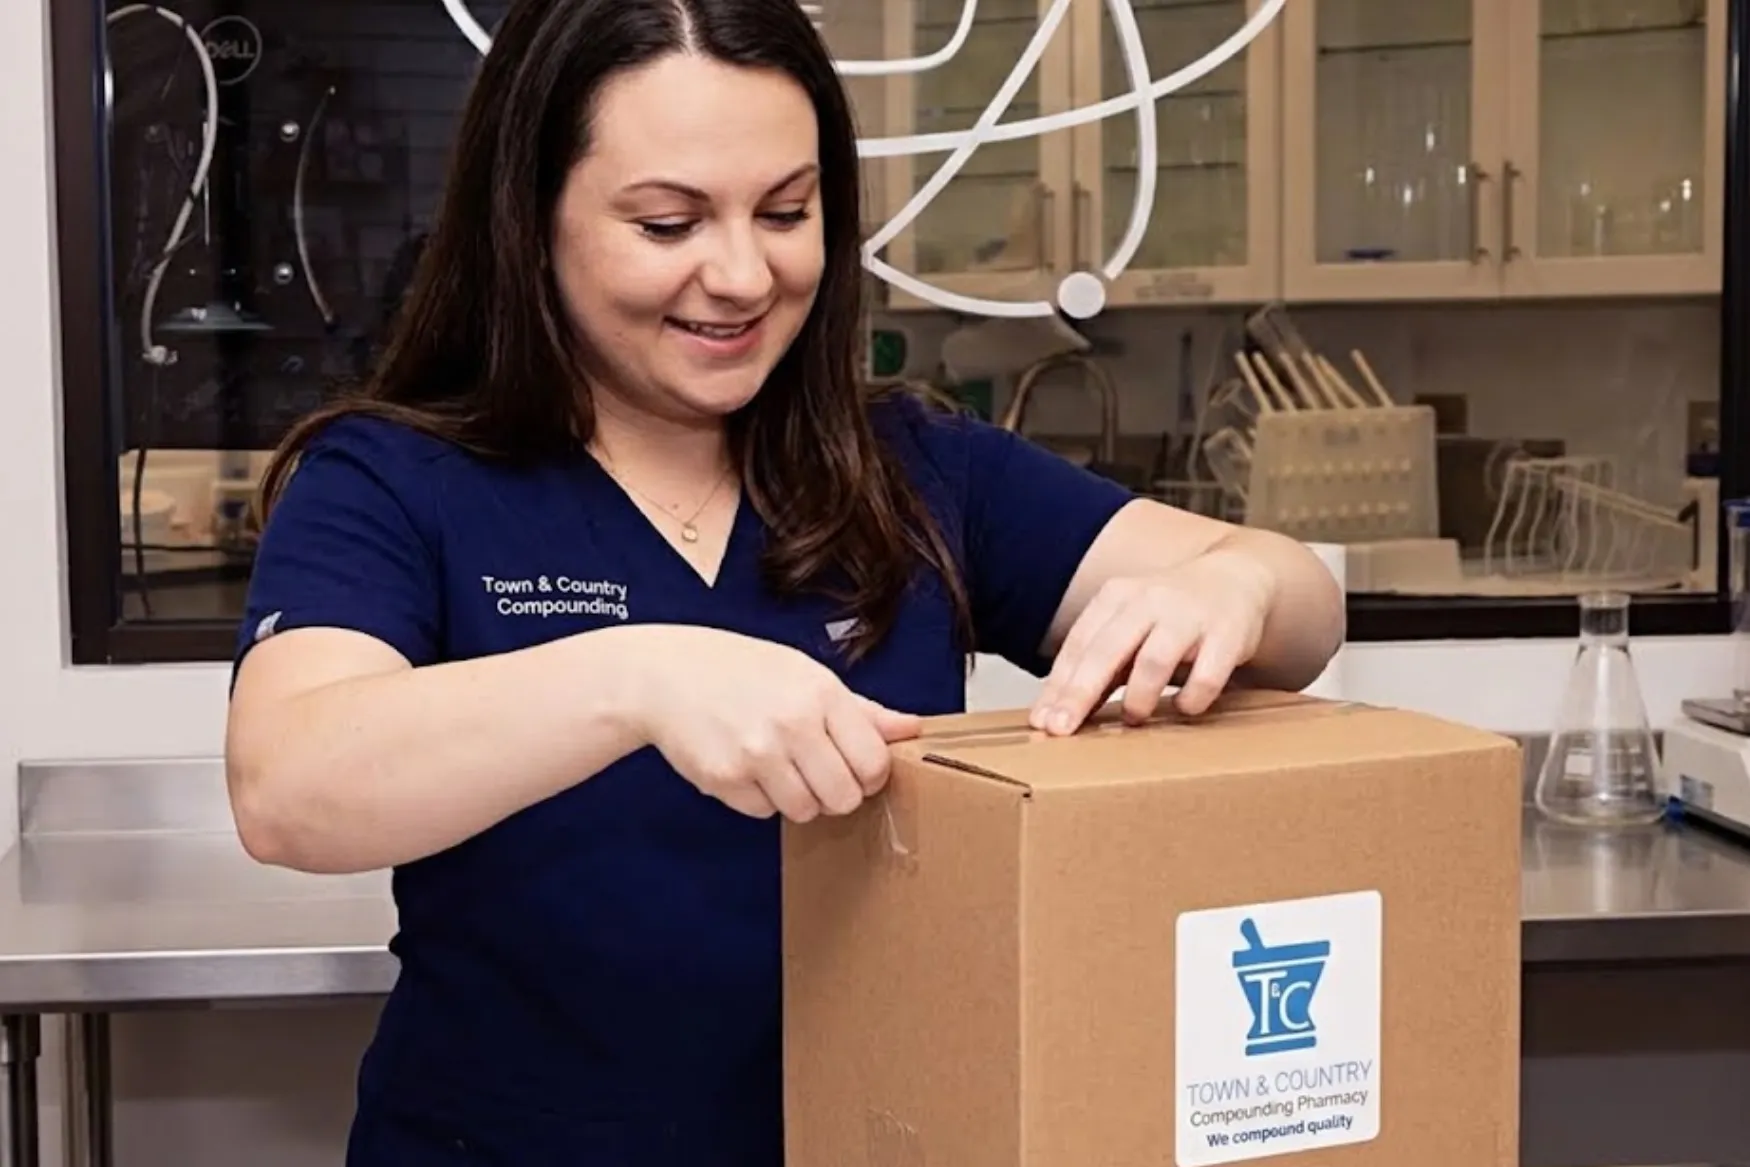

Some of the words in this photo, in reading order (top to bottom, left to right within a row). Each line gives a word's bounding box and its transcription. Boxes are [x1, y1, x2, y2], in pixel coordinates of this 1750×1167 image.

[481, 575, 534, 594] Town
[537, 575, 552, 593] &
[556, 576, 627, 601] Country
[497, 598, 629, 620] Compounding
[1187, 1075, 1250, 1106] TOWN
[1256, 1074, 1270, 1096] &
[1275, 1060, 1373, 1093] COUNTRY
[1190, 1099, 1294, 1127] Compounding
[1297, 1089, 1369, 1112] Pharmacy
[1206, 1132, 1229, 1147] We
[1232, 1121, 1304, 1144] compound
[1307, 1114, 1353, 1134] quality
